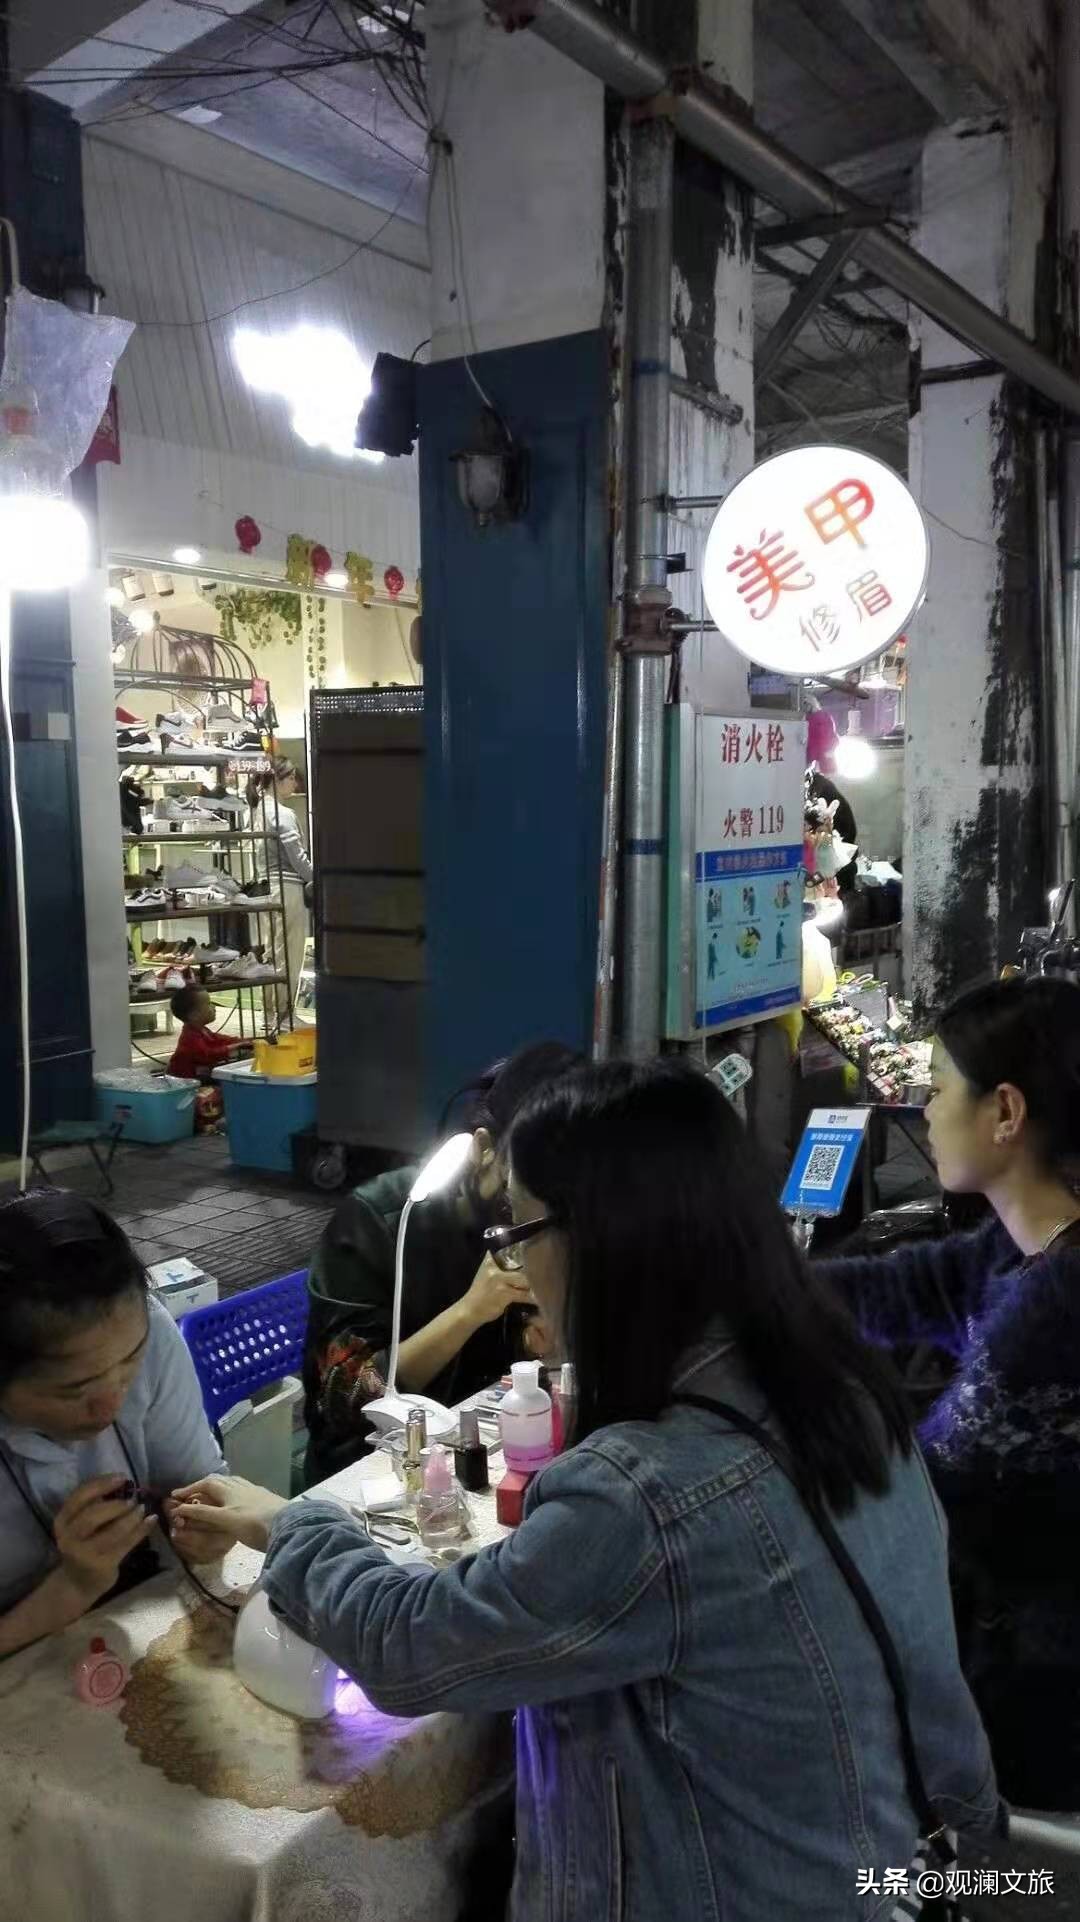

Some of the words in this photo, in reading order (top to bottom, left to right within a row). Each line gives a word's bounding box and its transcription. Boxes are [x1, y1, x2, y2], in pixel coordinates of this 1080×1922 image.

[726, 478, 875, 620] 美甲
[800, 569, 893, 652] 修眉
[721, 723, 785, 763] 消火栓
[723, 807, 753, 838] 火警
[759, 805, 785, 834] 119
